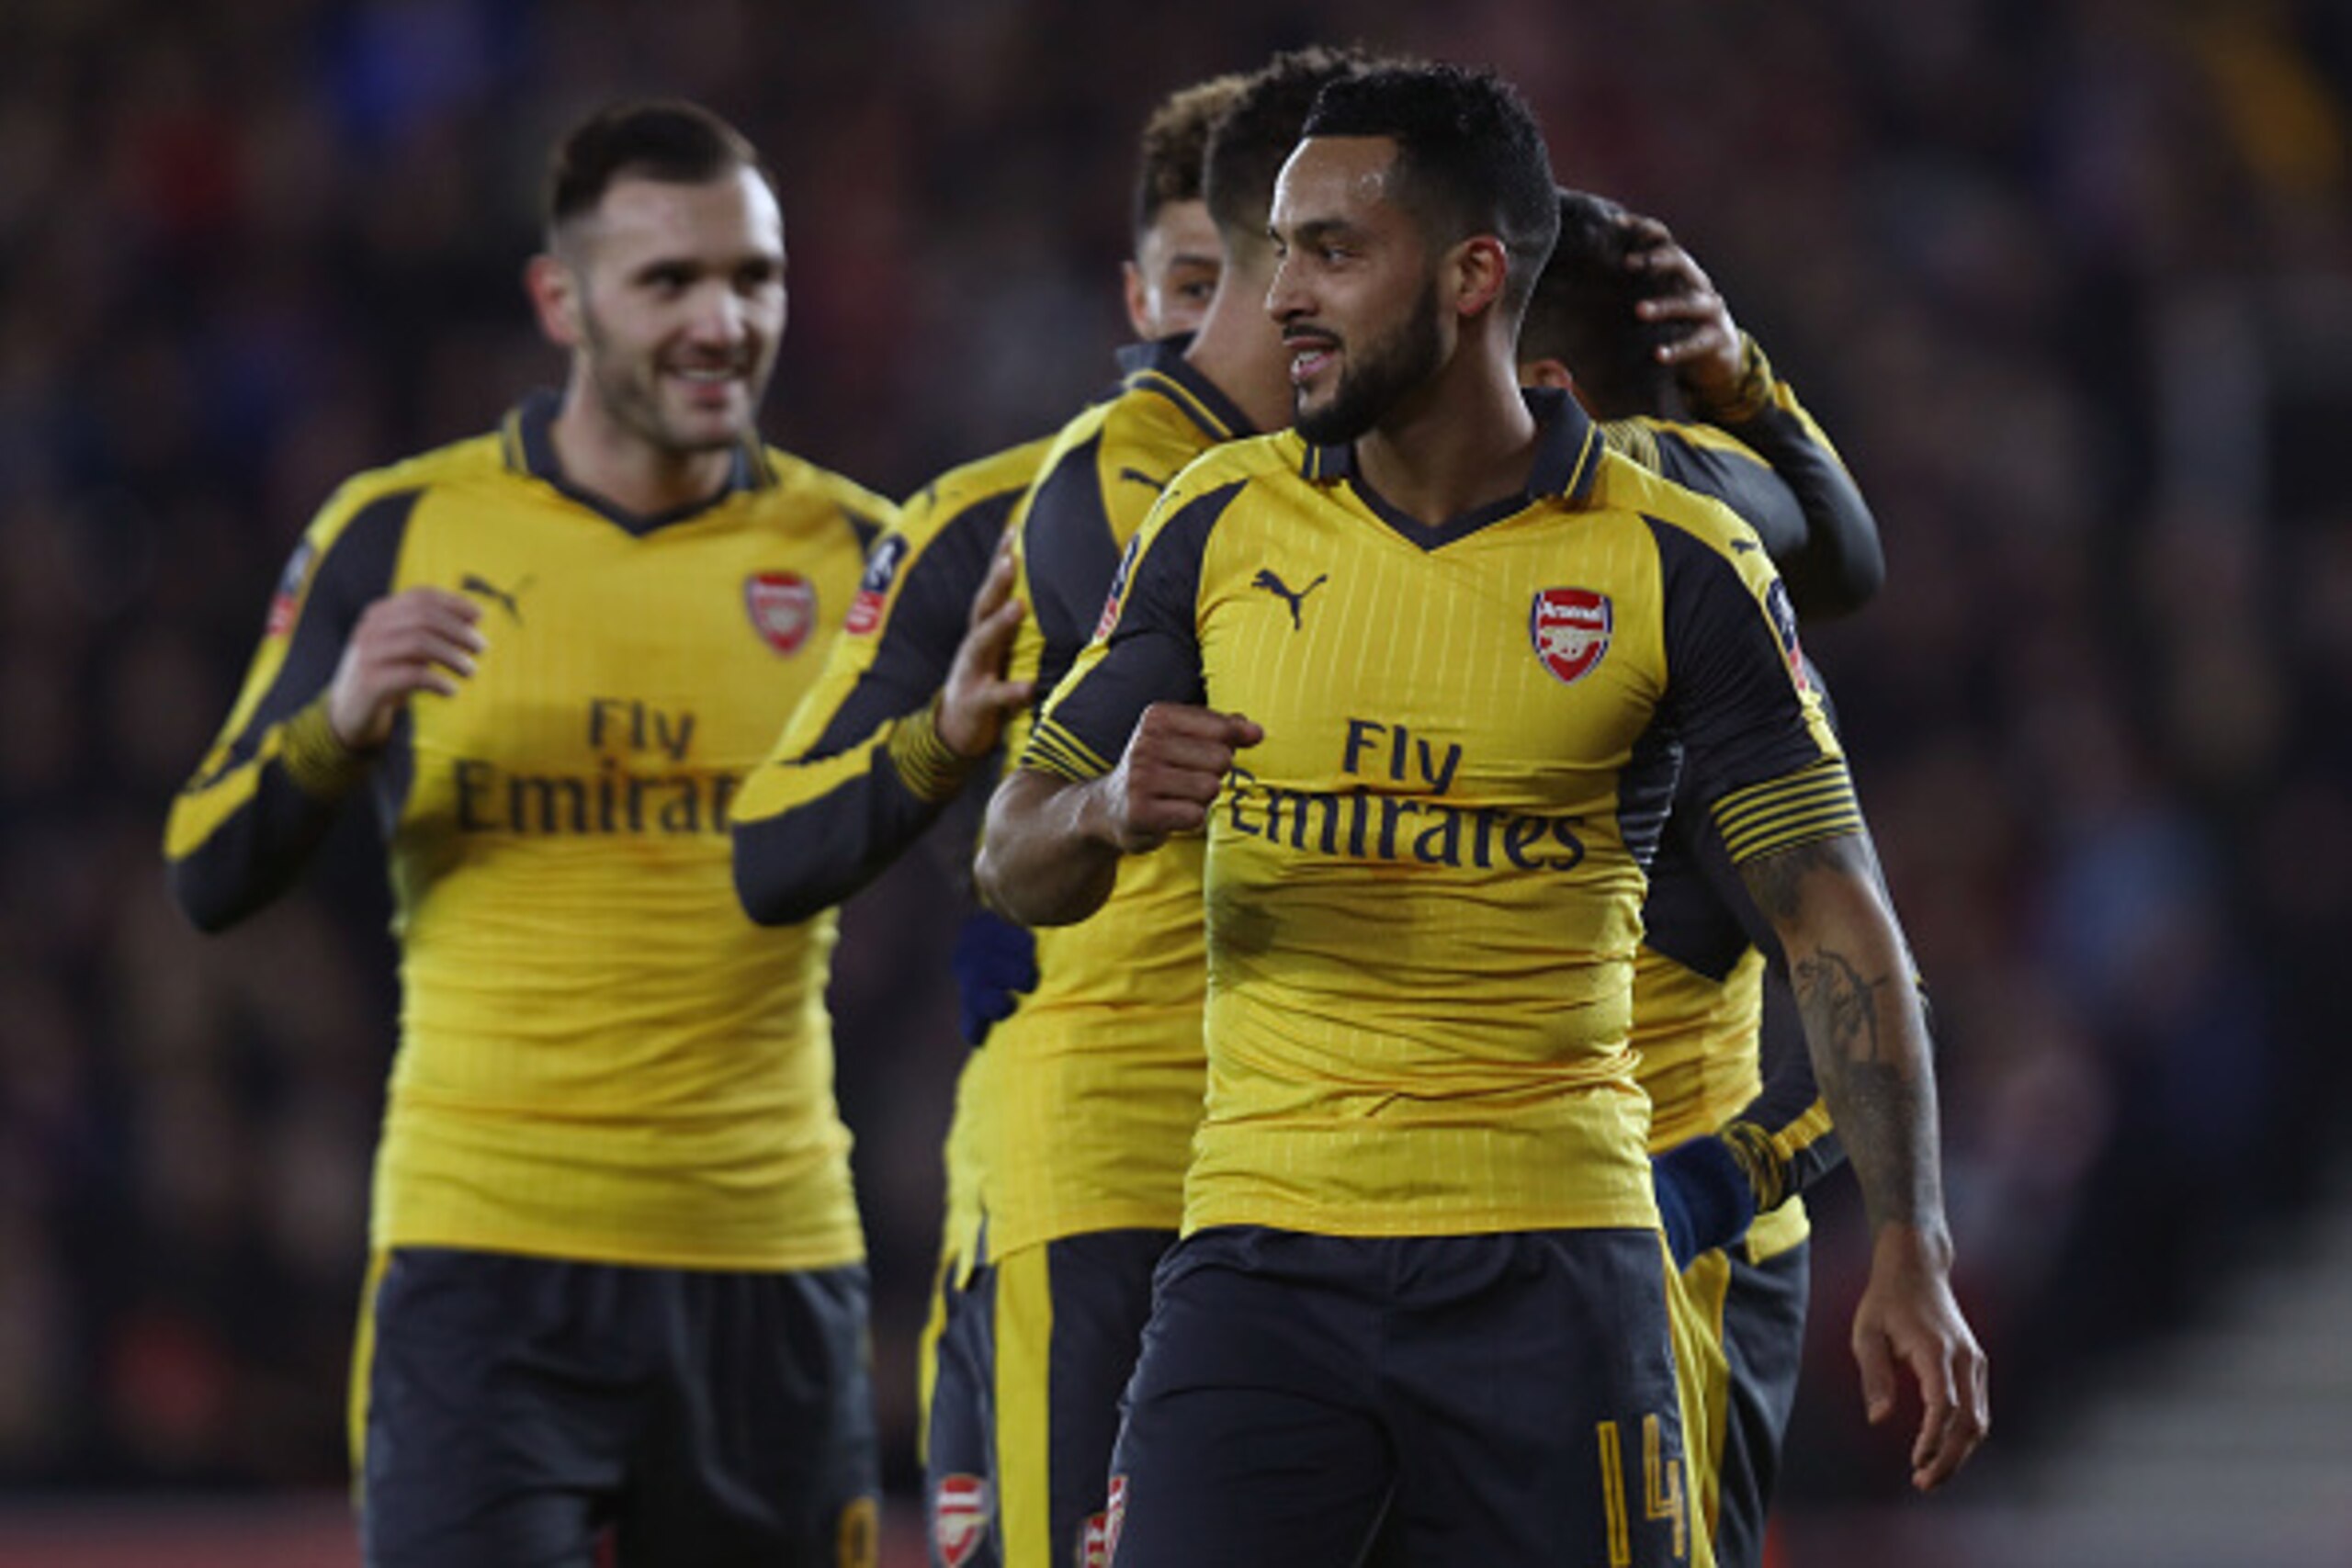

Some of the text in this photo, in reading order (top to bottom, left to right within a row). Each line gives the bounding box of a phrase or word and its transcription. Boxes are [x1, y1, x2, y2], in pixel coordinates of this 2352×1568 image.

[587, 696, 695, 761] Fly
[1342, 718, 1462, 795] Fly
[454, 758, 742, 833] Emirat
[1225, 767, 1585, 871] Emirates
[1597, 1413, 1685, 1568] 14
